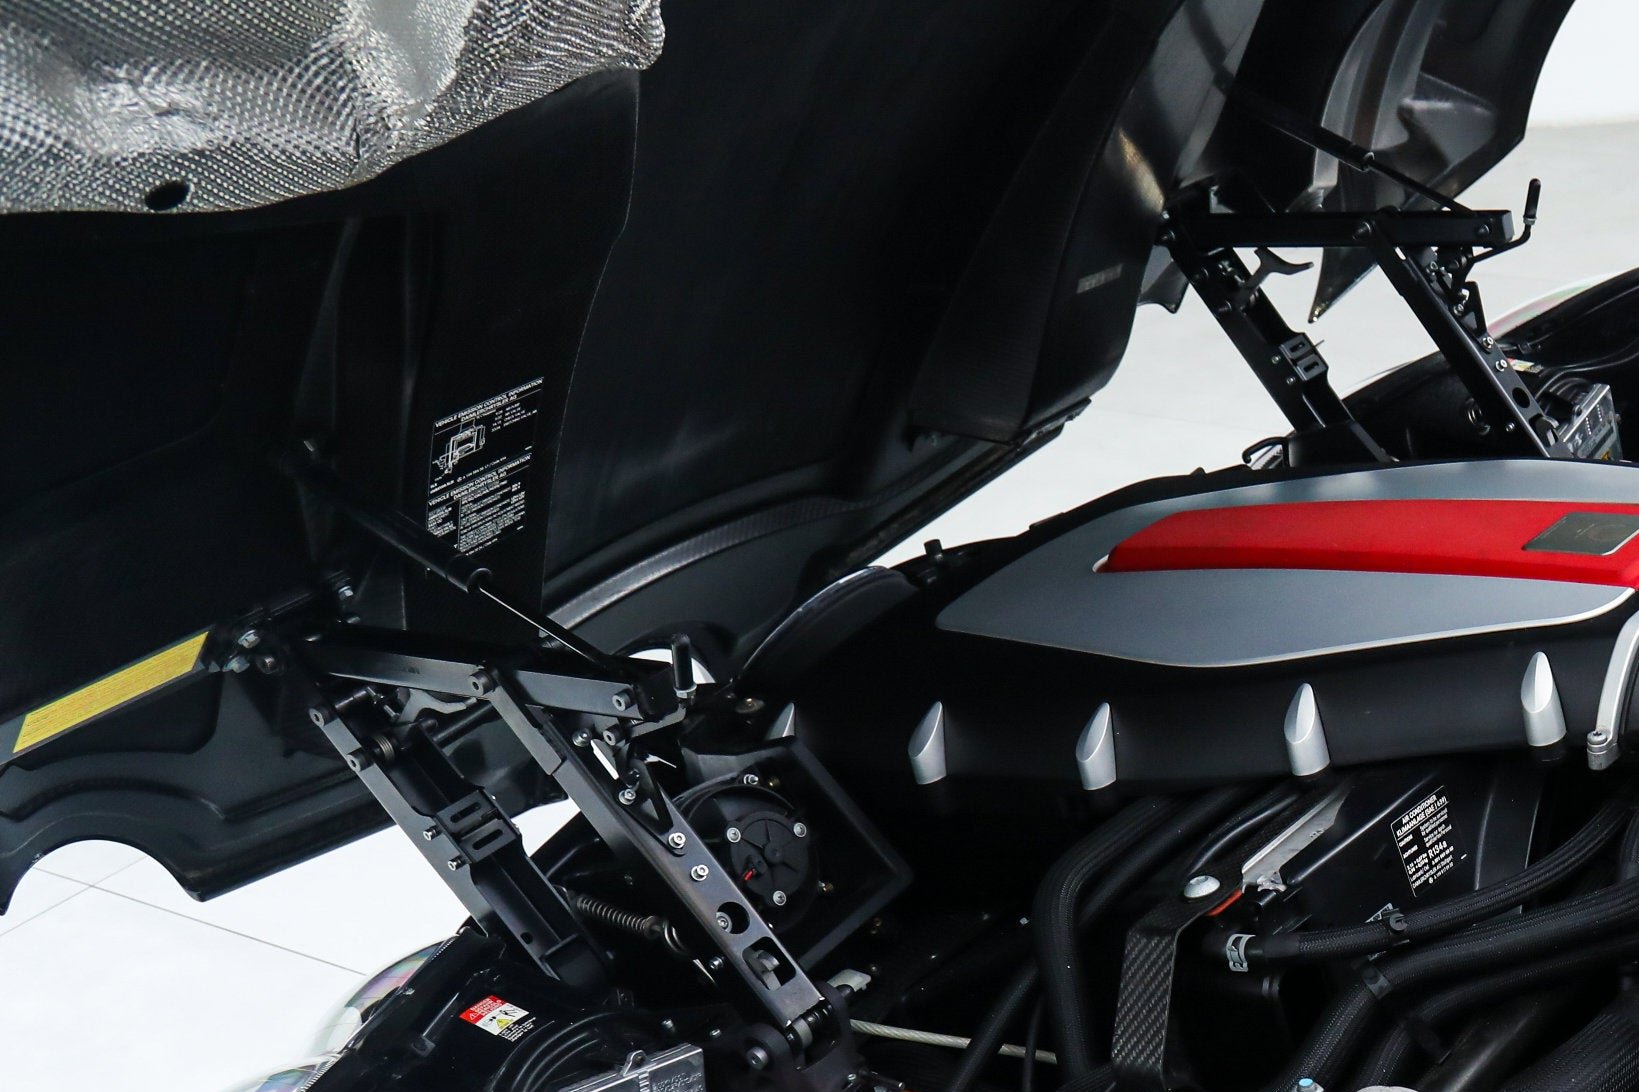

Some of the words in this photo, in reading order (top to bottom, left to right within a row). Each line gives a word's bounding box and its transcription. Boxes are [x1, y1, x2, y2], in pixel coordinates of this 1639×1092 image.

[435, 414, 457, 427] VEHICLE
[458, 403, 483, 418] EMISSION
[484, 394, 507, 407] CONTROL
[508, 379, 543, 397] INFORMATION
[428, 492, 450, 506] VEHICLE
[450, 481, 474, 496] EMISSION
[475, 471, 497, 485] CONTROL
[498, 455, 531, 473] INFORMATION
[1396, 811, 1425, 837] KLIMAANLAGE
[1401, 814, 1409, 824] AIR
[1408, 794, 1437, 818] CONDITIONER
[1427, 837, 1447, 860] R134a
